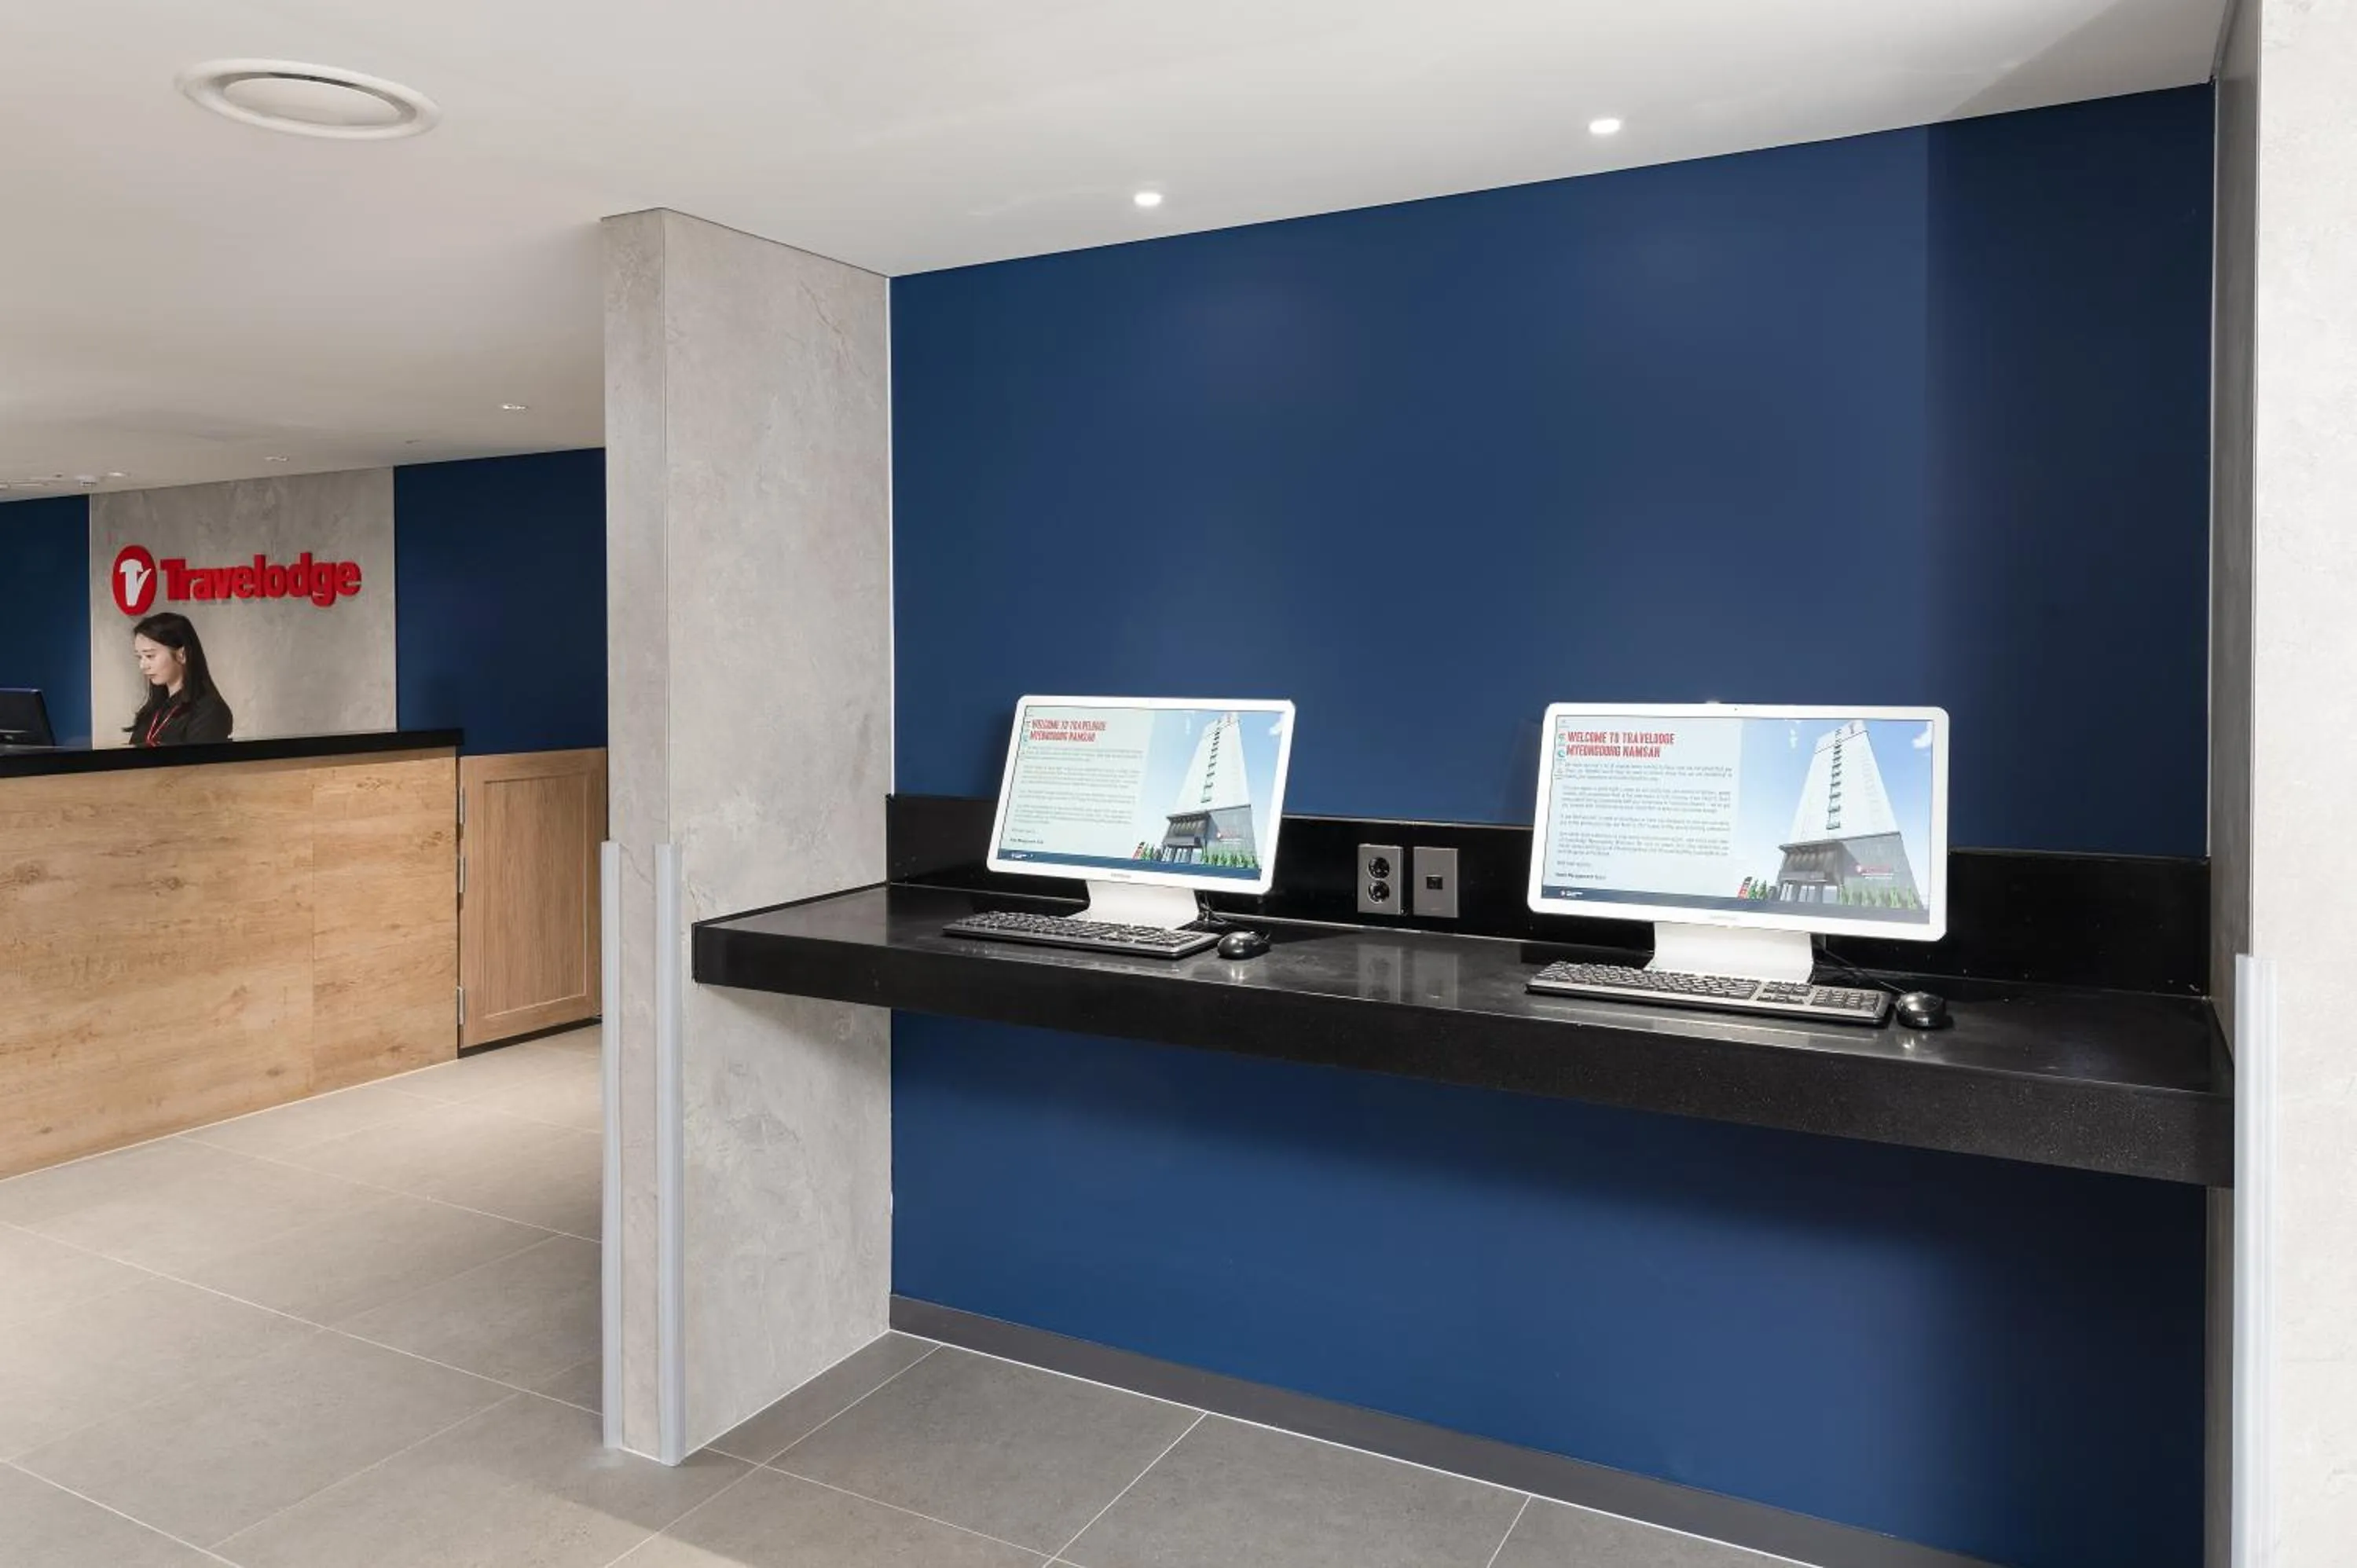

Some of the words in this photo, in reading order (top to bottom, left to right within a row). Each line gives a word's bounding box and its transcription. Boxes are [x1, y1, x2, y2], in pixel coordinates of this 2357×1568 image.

[160, 552, 362, 608] Travelodge
[1567, 731, 1607, 743] WELCOME
[1610, 731, 1619, 743] TO
[1622, 731, 1675, 745] TRAVELODGE
